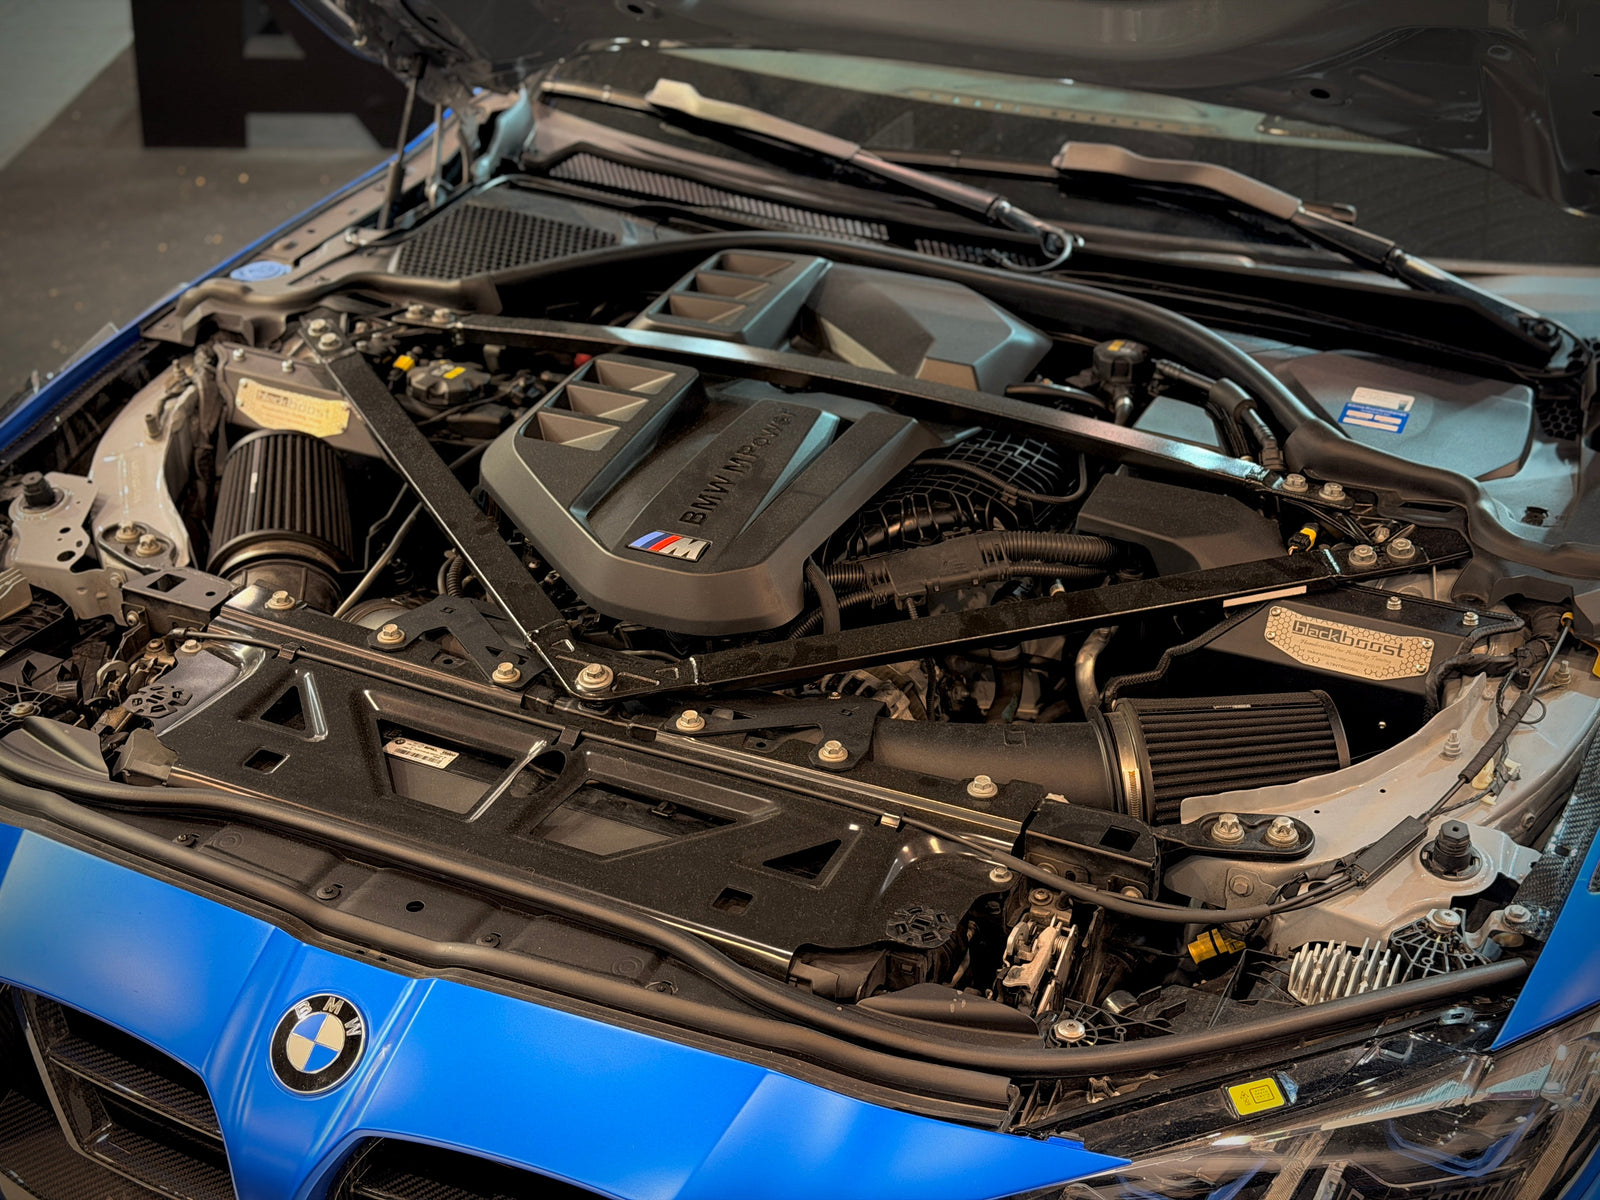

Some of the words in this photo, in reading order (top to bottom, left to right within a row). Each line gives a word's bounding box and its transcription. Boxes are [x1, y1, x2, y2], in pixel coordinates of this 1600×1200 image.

[679, 474, 737, 526] BMW
[1292, 620, 1406, 658] blackboost
[294, 996, 362, 1037] BMW
